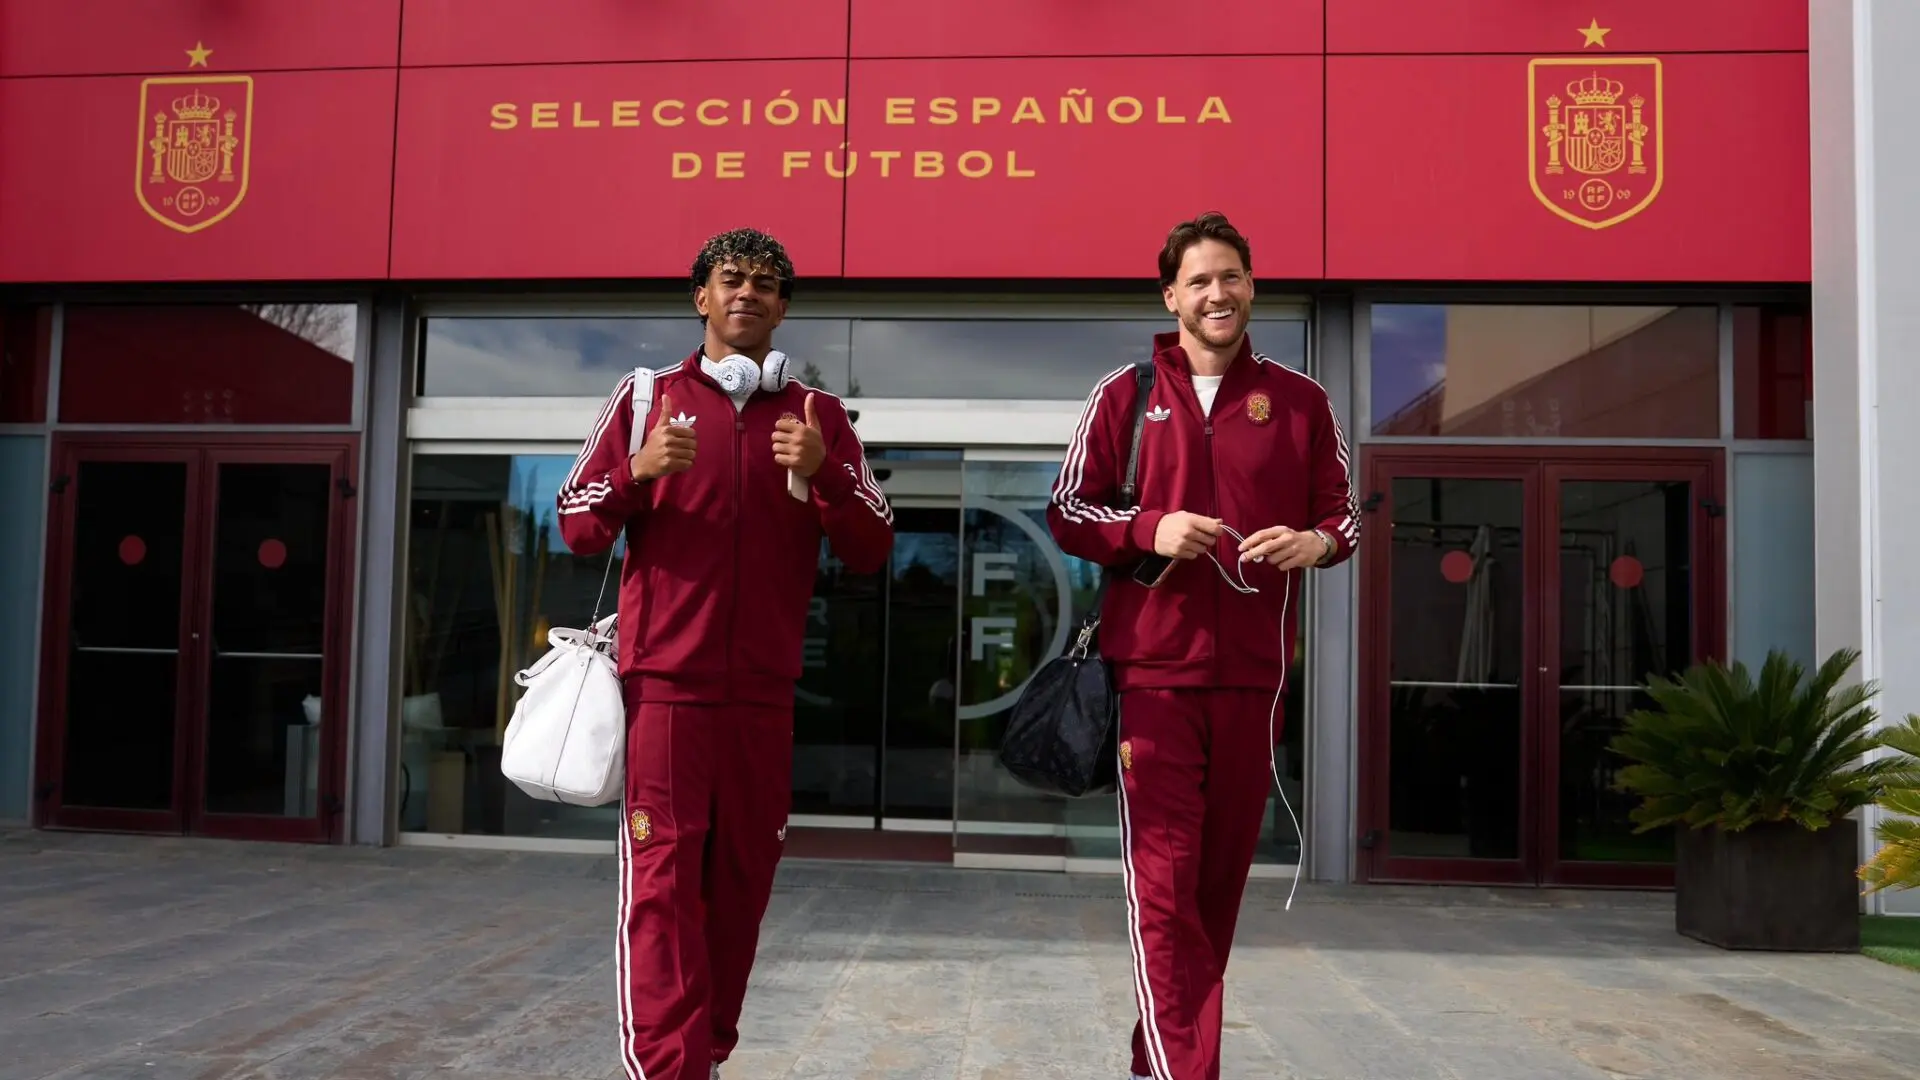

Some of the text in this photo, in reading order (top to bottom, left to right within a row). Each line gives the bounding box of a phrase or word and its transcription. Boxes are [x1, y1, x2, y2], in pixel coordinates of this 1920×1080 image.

[491, 88, 1231, 129] SELECCIÓN ESPAÑOLA
[672, 141, 1036, 178] DE FÚTBOL
[972, 553, 1018, 597] F
[971, 617, 1017, 661] F
